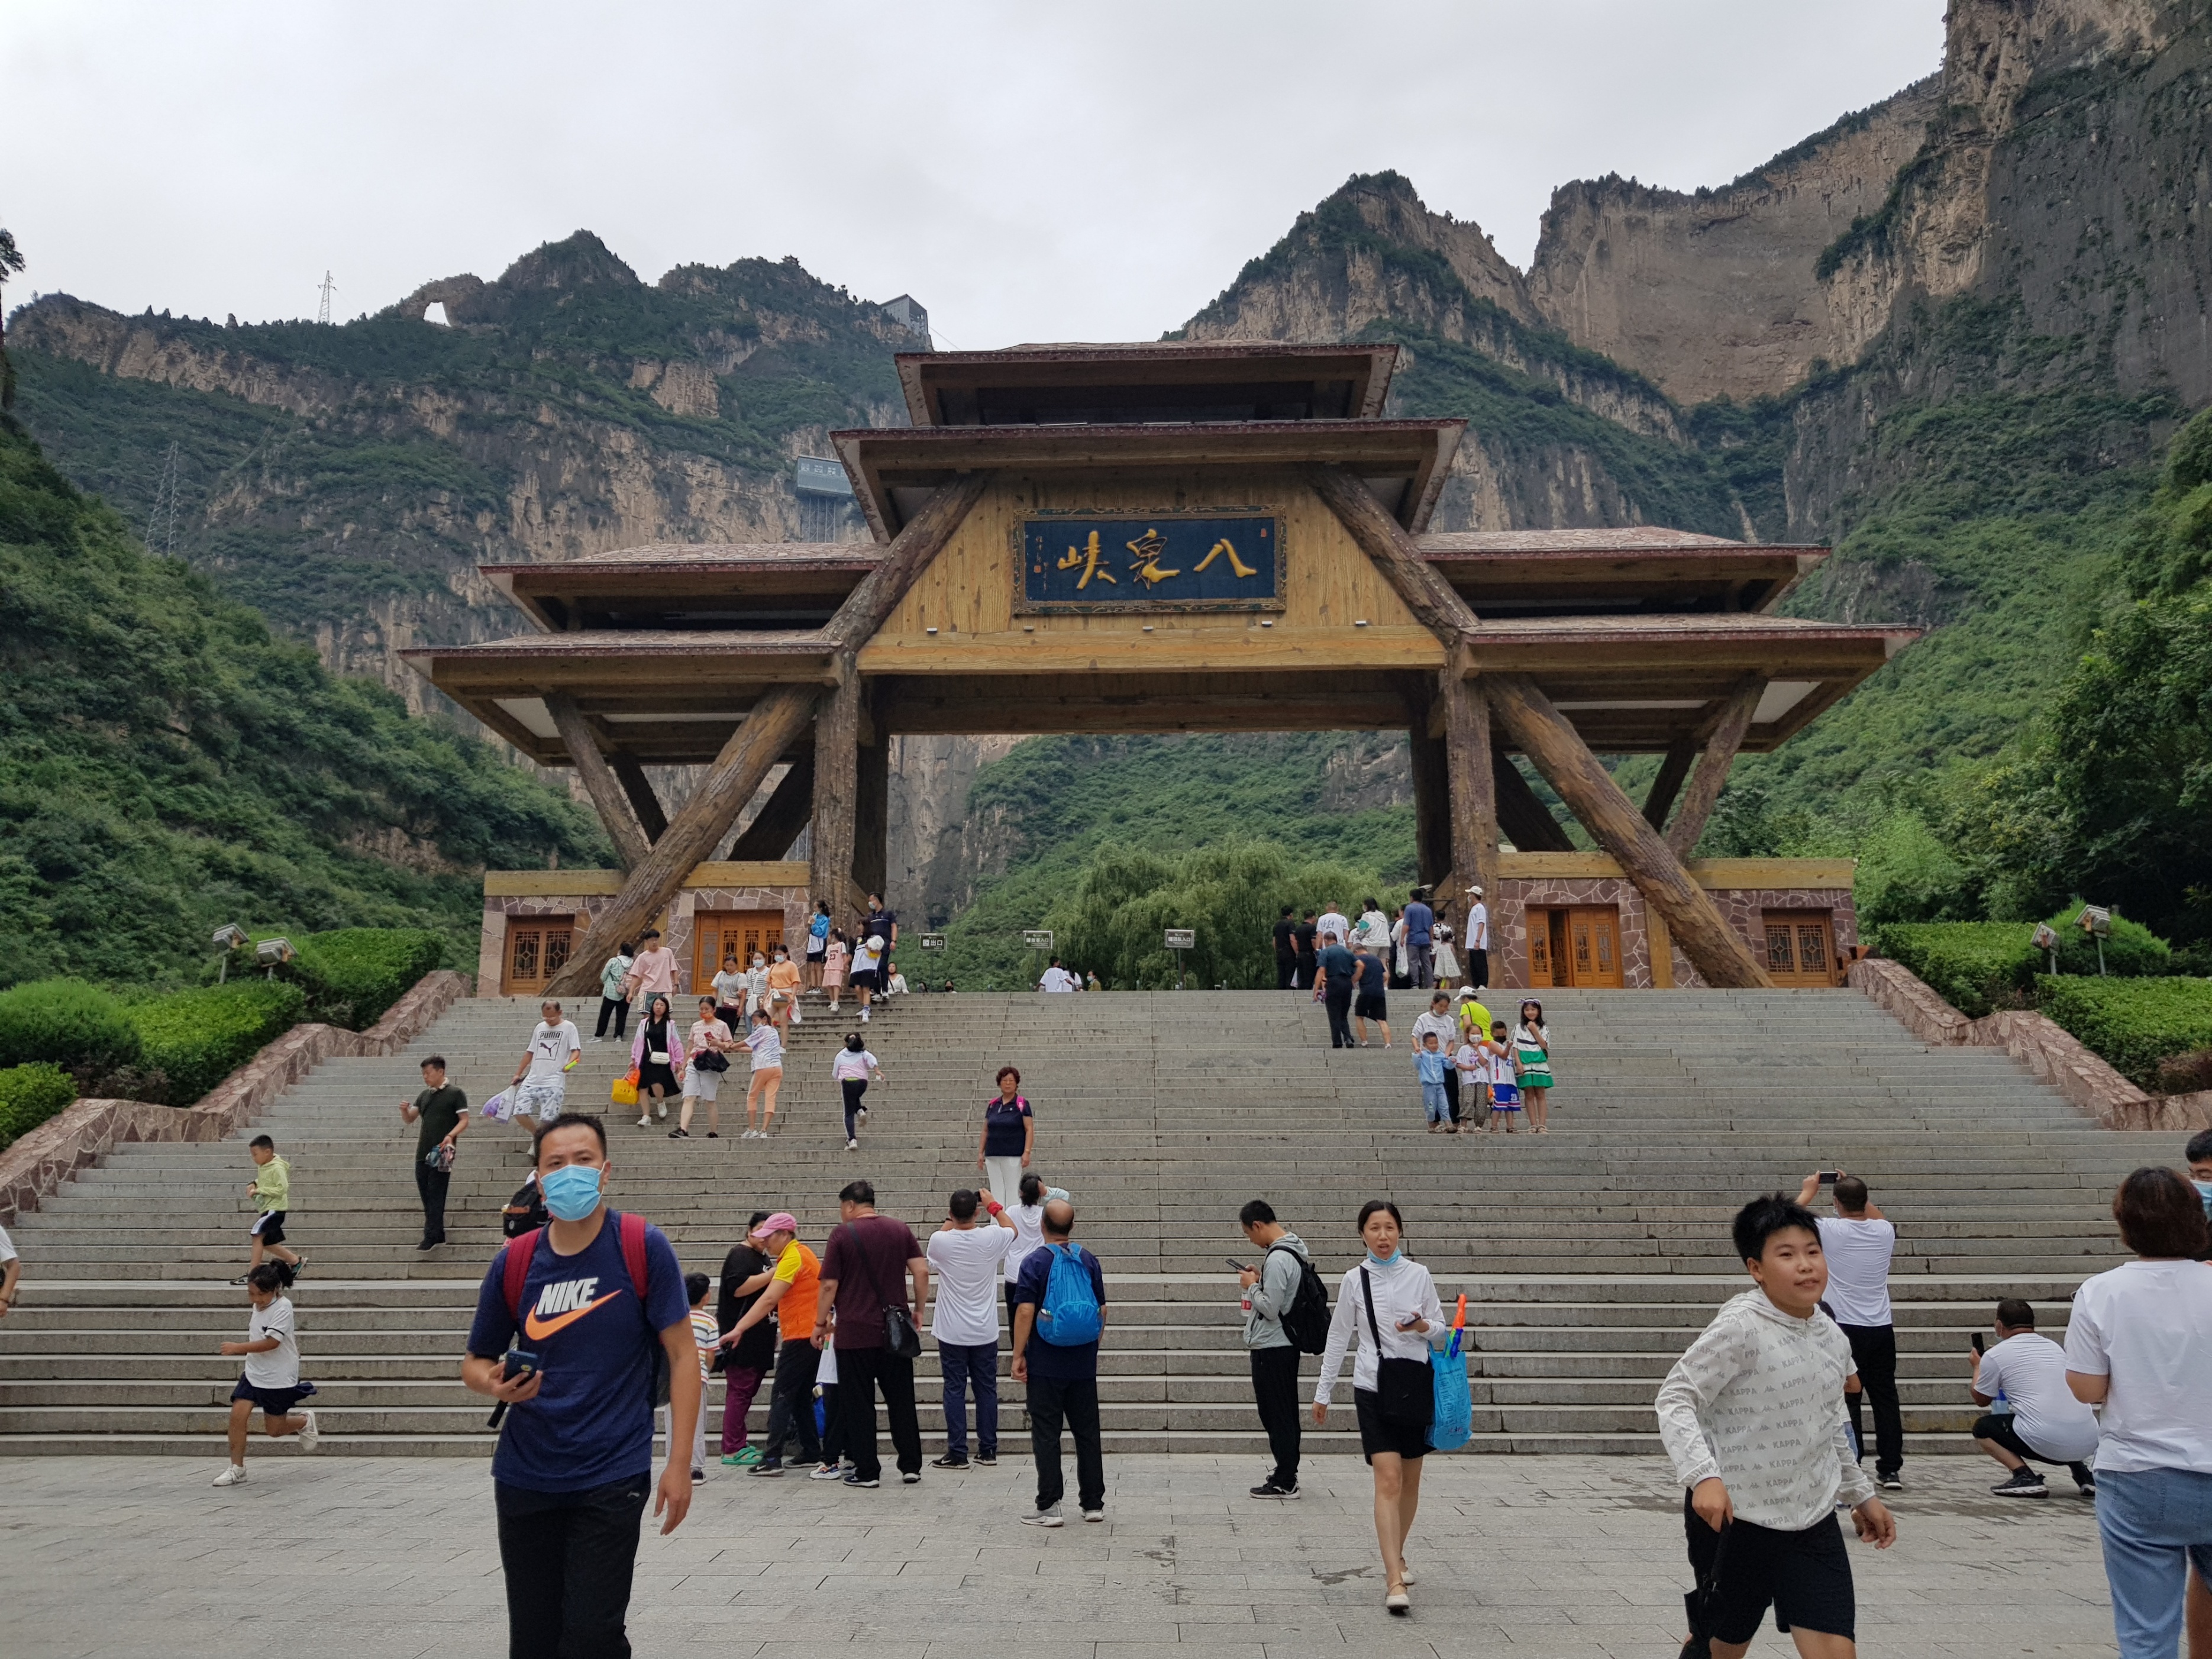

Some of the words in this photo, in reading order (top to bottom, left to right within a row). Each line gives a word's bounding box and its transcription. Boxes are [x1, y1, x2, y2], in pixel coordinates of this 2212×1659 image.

[535, 1277, 600, 1315] NIKE
[1781, 1376, 1807, 1389] KAPPA
[1730, 1388, 1757, 1396] KAPPA
[1779, 1397, 1805, 1410] KAPPA
[1727, 1406, 1755, 1415] KAPPA
[1776, 1418, 1804, 1429] KAPPA
[1725, 1425, 1752, 1435] KAPPA
[1773, 1439, 1802, 1449] KAPPA
[1720, 1445, 1749, 1454] KAPPA
[1769, 1459, 1798, 1468] KAPPA
[1765, 1477, 1794, 1487] KAPPA
[1763, 1497, 1791, 1506] KAPPA
[1761, 1516, 1790, 1526] KAPPA
